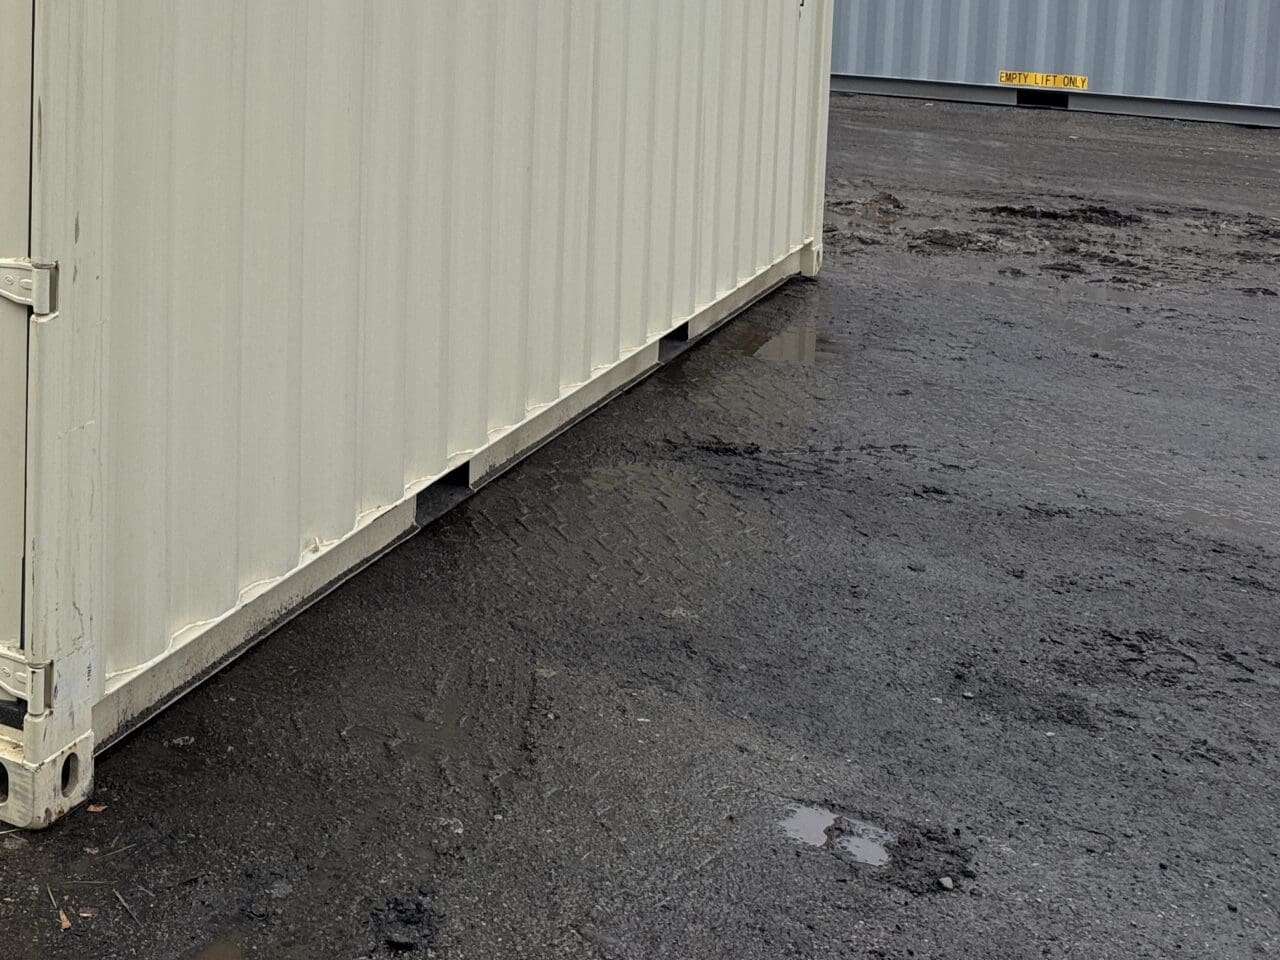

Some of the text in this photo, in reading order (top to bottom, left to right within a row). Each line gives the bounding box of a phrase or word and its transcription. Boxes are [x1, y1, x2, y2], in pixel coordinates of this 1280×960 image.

[1000, 71, 1087, 88] EMPTY LIFT ONLY
